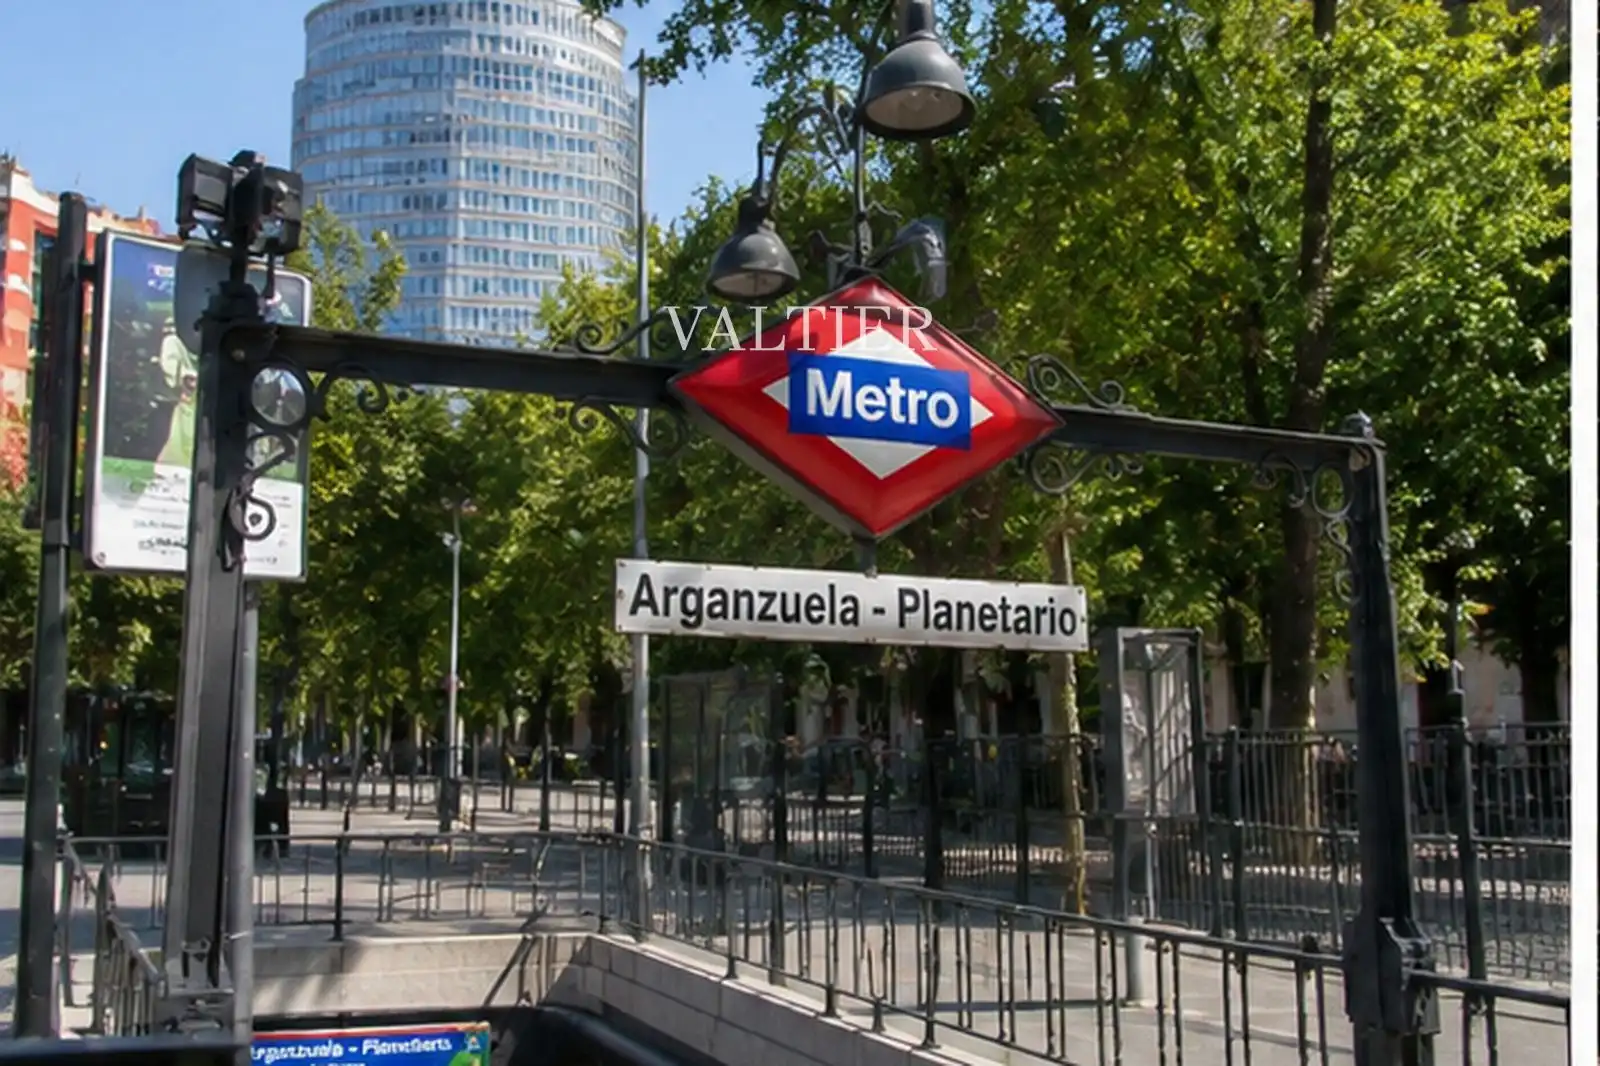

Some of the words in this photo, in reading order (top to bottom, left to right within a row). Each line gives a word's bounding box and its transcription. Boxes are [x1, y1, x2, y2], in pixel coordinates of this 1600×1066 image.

[806, 367, 959, 429] Metro
[629, 572, 860, 629] Arganzuela
[898, 587, 1078, 636] Planetario
